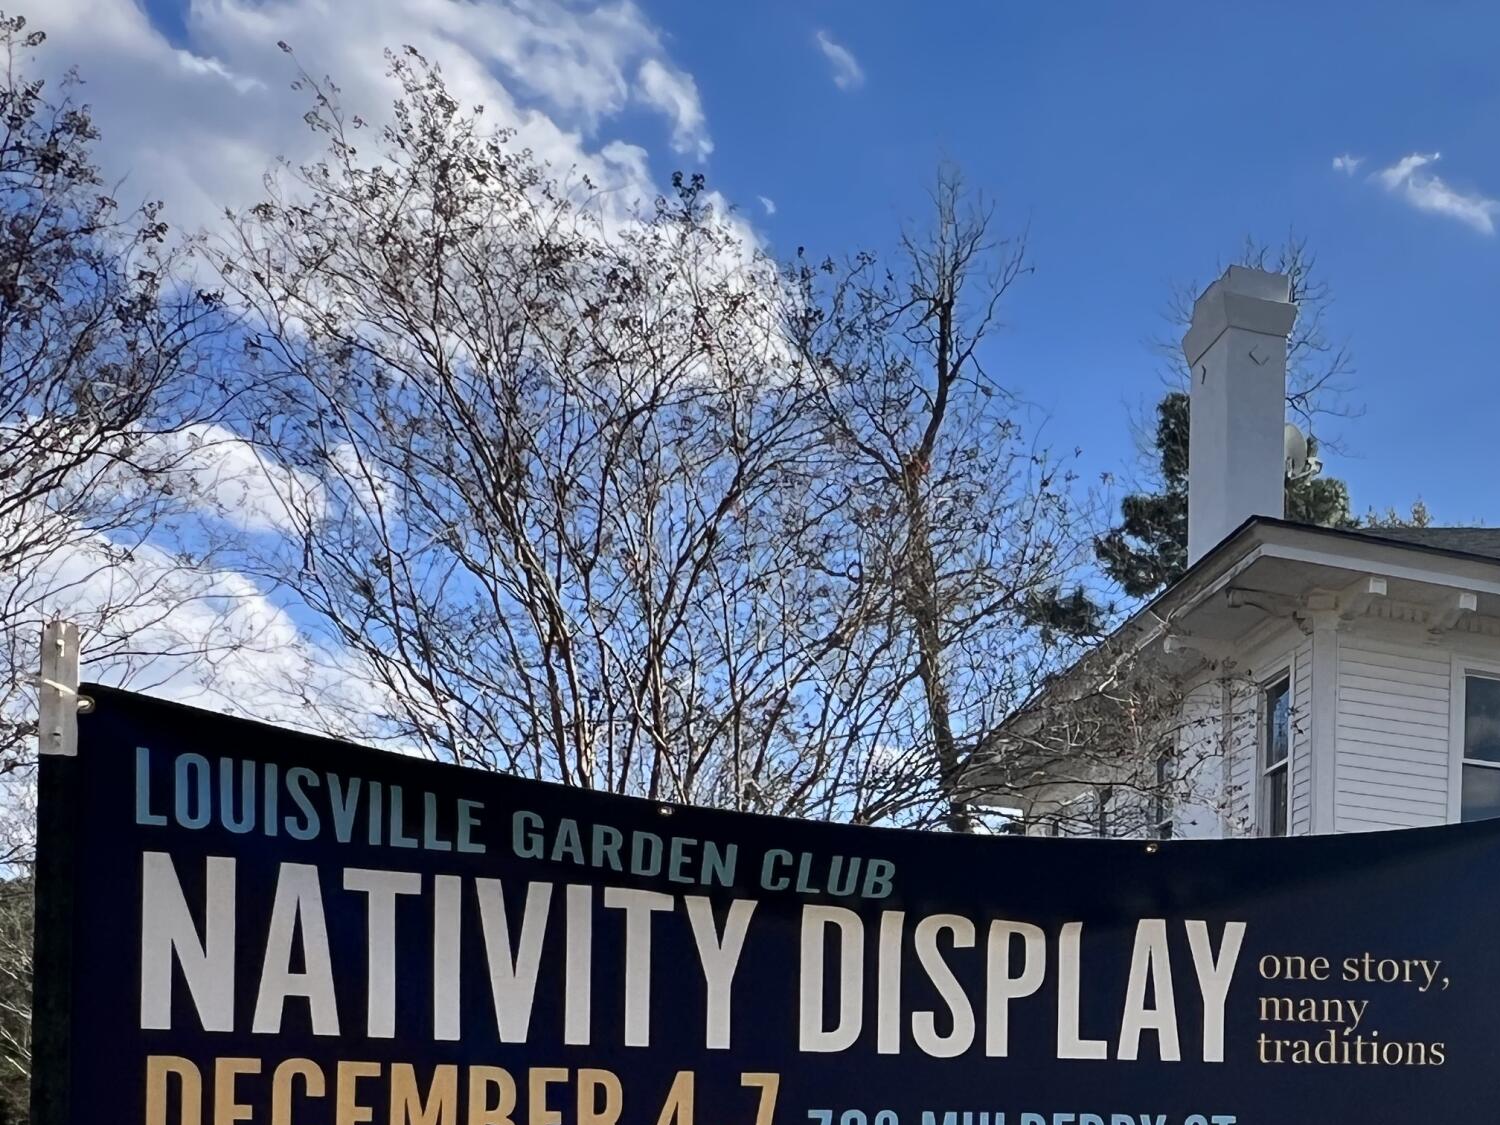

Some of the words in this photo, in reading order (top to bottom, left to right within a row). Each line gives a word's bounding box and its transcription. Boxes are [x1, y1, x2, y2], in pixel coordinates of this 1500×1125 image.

[136, 747, 486, 854] LOUISVILLE
[513, 810, 738, 887] GARDEN
[761, 849, 896, 898] CLUB
[140, 851, 759, 1050] NATIVITY
[798, 903, 1248, 1063] DISPLAY
[1258, 954, 1330, 981] one
[1342, 951, 1450, 993] story,
[1258, 997, 1369, 1036] many
[1256, 1029, 1445, 1066] traditions
